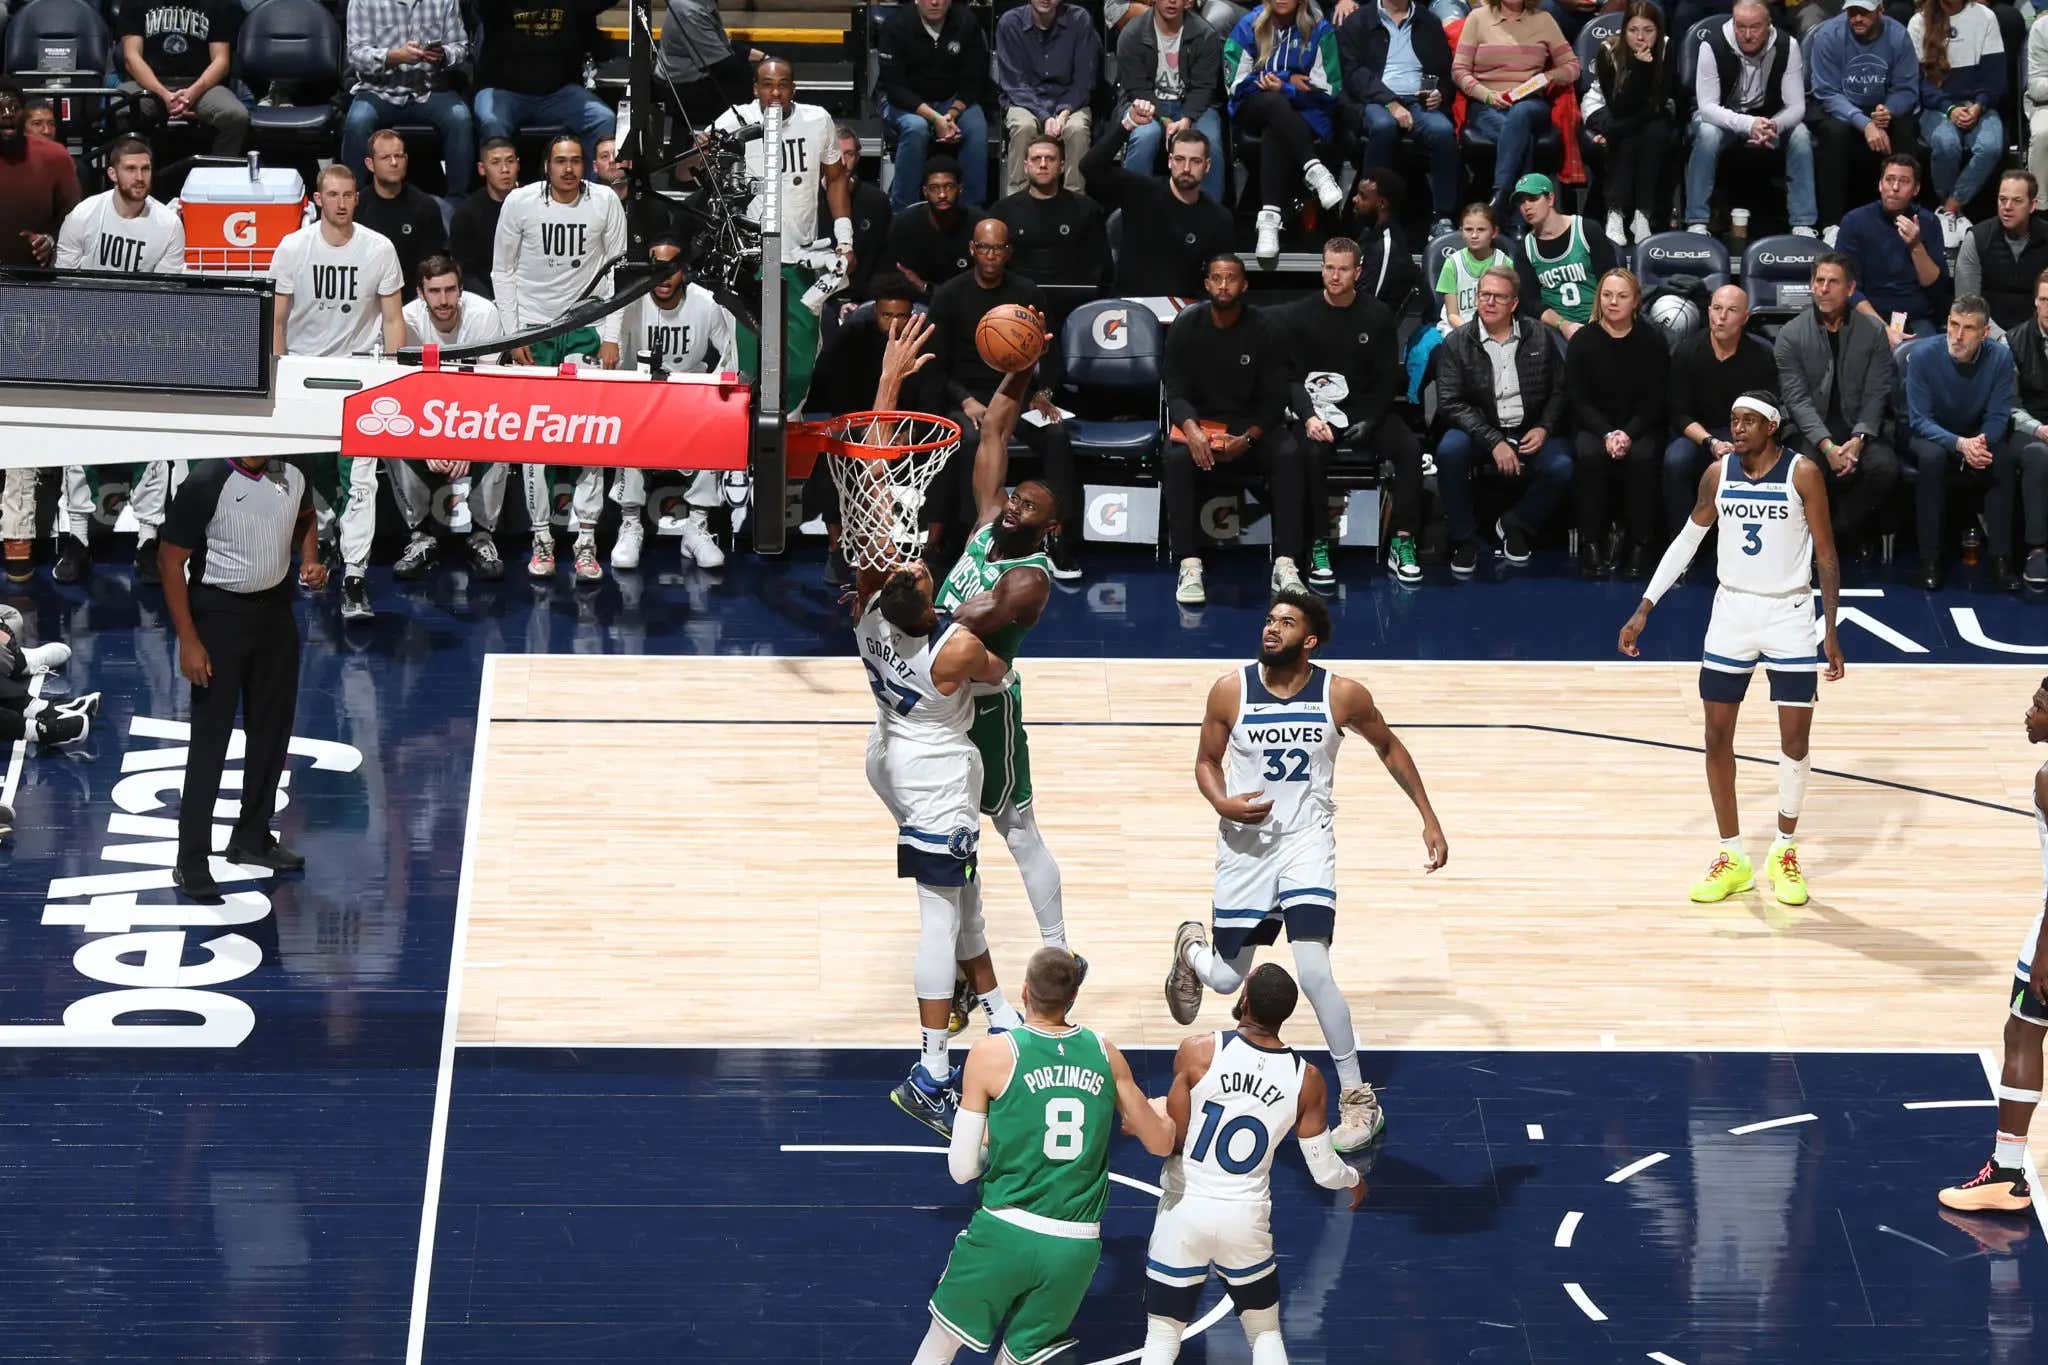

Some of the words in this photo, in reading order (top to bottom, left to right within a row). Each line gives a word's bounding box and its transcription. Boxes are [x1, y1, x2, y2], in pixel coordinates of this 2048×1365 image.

[146, 6, 209, 40] WOLVES
[223, 211, 257, 247] G
[541, 223, 587, 256] VOTE
[100, 232, 146, 272] VOTE
[1666, 250, 1711, 259] LEXUS
[313, 264, 358, 301] VOTE
[1538, 263, 1587, 289] BOSTON
[1559, 282, 1581, 307] 0
[648, 325, 690, 355] VOTE
[1092, 309, 1128, 350] G
[1087, 493, 1128, 536] G
[1721, 504, 1788, 519] WOLVES
[1742, 523, 1762, 556] 3
[866, 637, 916, 680] GOBERT
[861, 656, 923, 717] 27
[1248, 728, 1323, 744] WOLVES
[1263, 748, 1310, 782] 32
[1023, 1065, 1104, 1096] PORZINGIS
[1220, 1072, 1285, 1107] CONLEY
[1043, 1097, 1085, 1160] 8
[1190, 1100, 1269, 1175] 10
